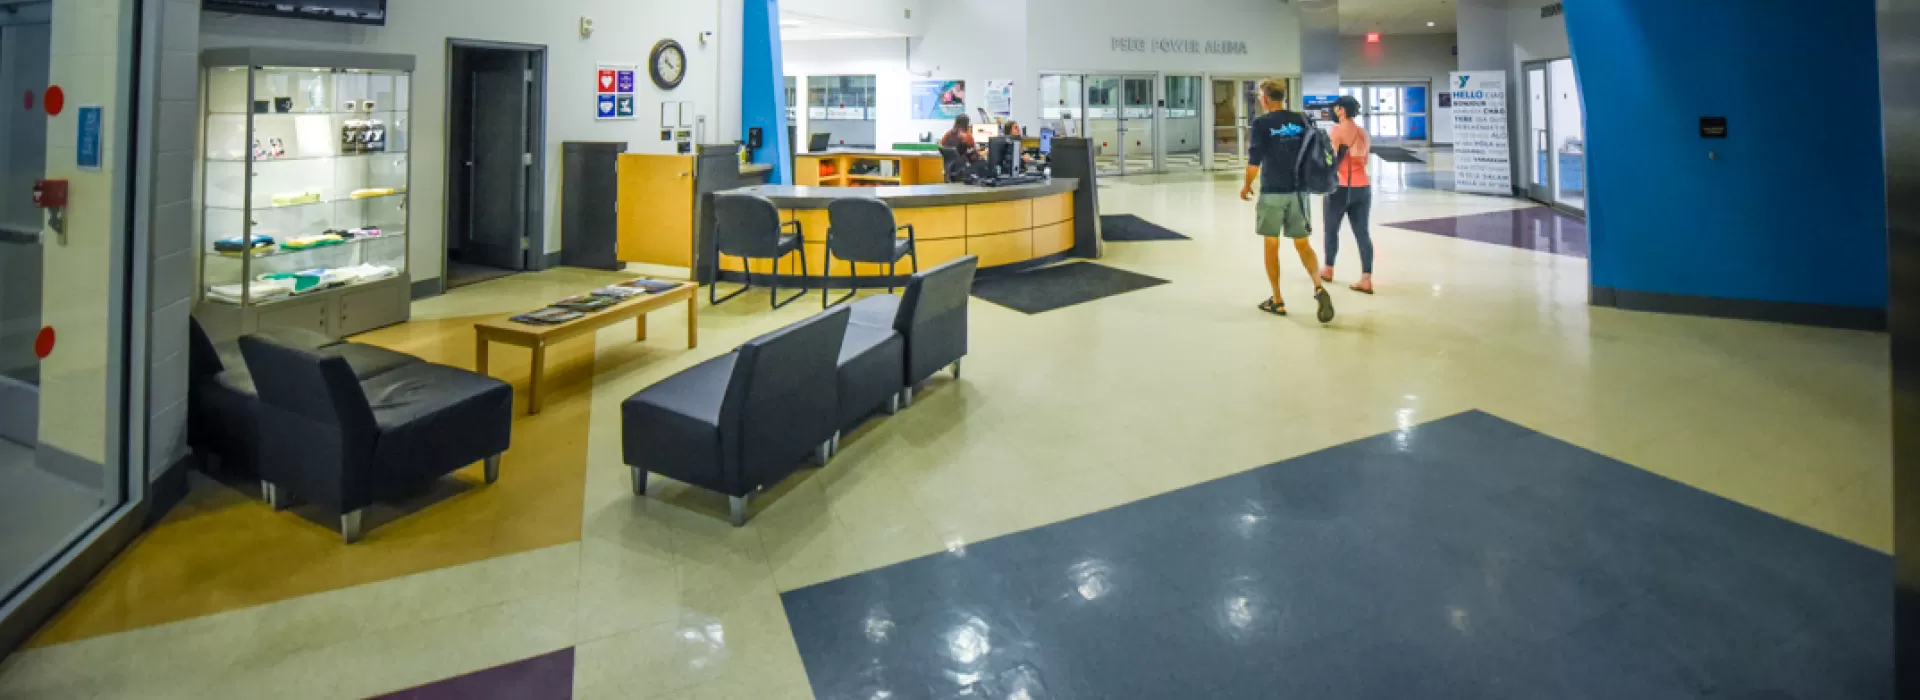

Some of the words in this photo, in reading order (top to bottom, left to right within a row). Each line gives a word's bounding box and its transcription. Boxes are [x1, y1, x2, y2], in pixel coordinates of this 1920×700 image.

[1151, 38, 1200, 53] POWER
[1204, 39, 1248, 55] ARENA
[1453, 91, 1483, 99] HELLO
